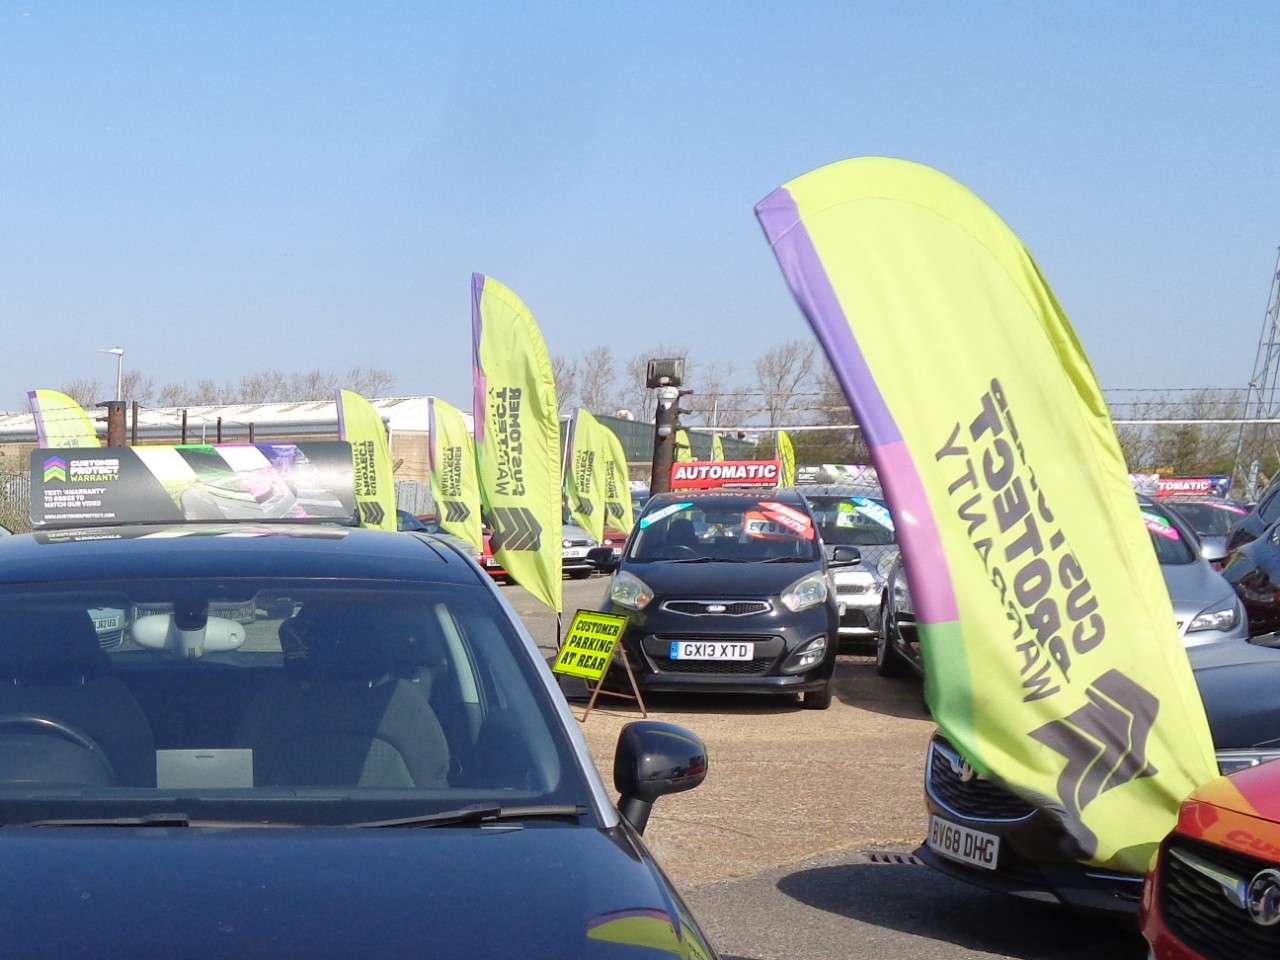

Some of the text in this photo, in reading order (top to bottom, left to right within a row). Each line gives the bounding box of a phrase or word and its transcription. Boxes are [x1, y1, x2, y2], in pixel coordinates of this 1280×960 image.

[70, 459, 119, 467] CUSTOMER
[70, 466, 119, 475] PROTECT
[675, 464, 778, 480] AUTOMATIC
[71, 474, 119, 482] WARRANTY
[1160, 481, 1209, 489] TOMATIC
[576, 620, 620, 636] CUSTOMER
[569, 635, 613, 653] PARKING
[685, 644, 747, 657] GX13 XTD
[561, 652, 607, 671] AT REAR
[932, 822, 995, 864] BV68 DHG
